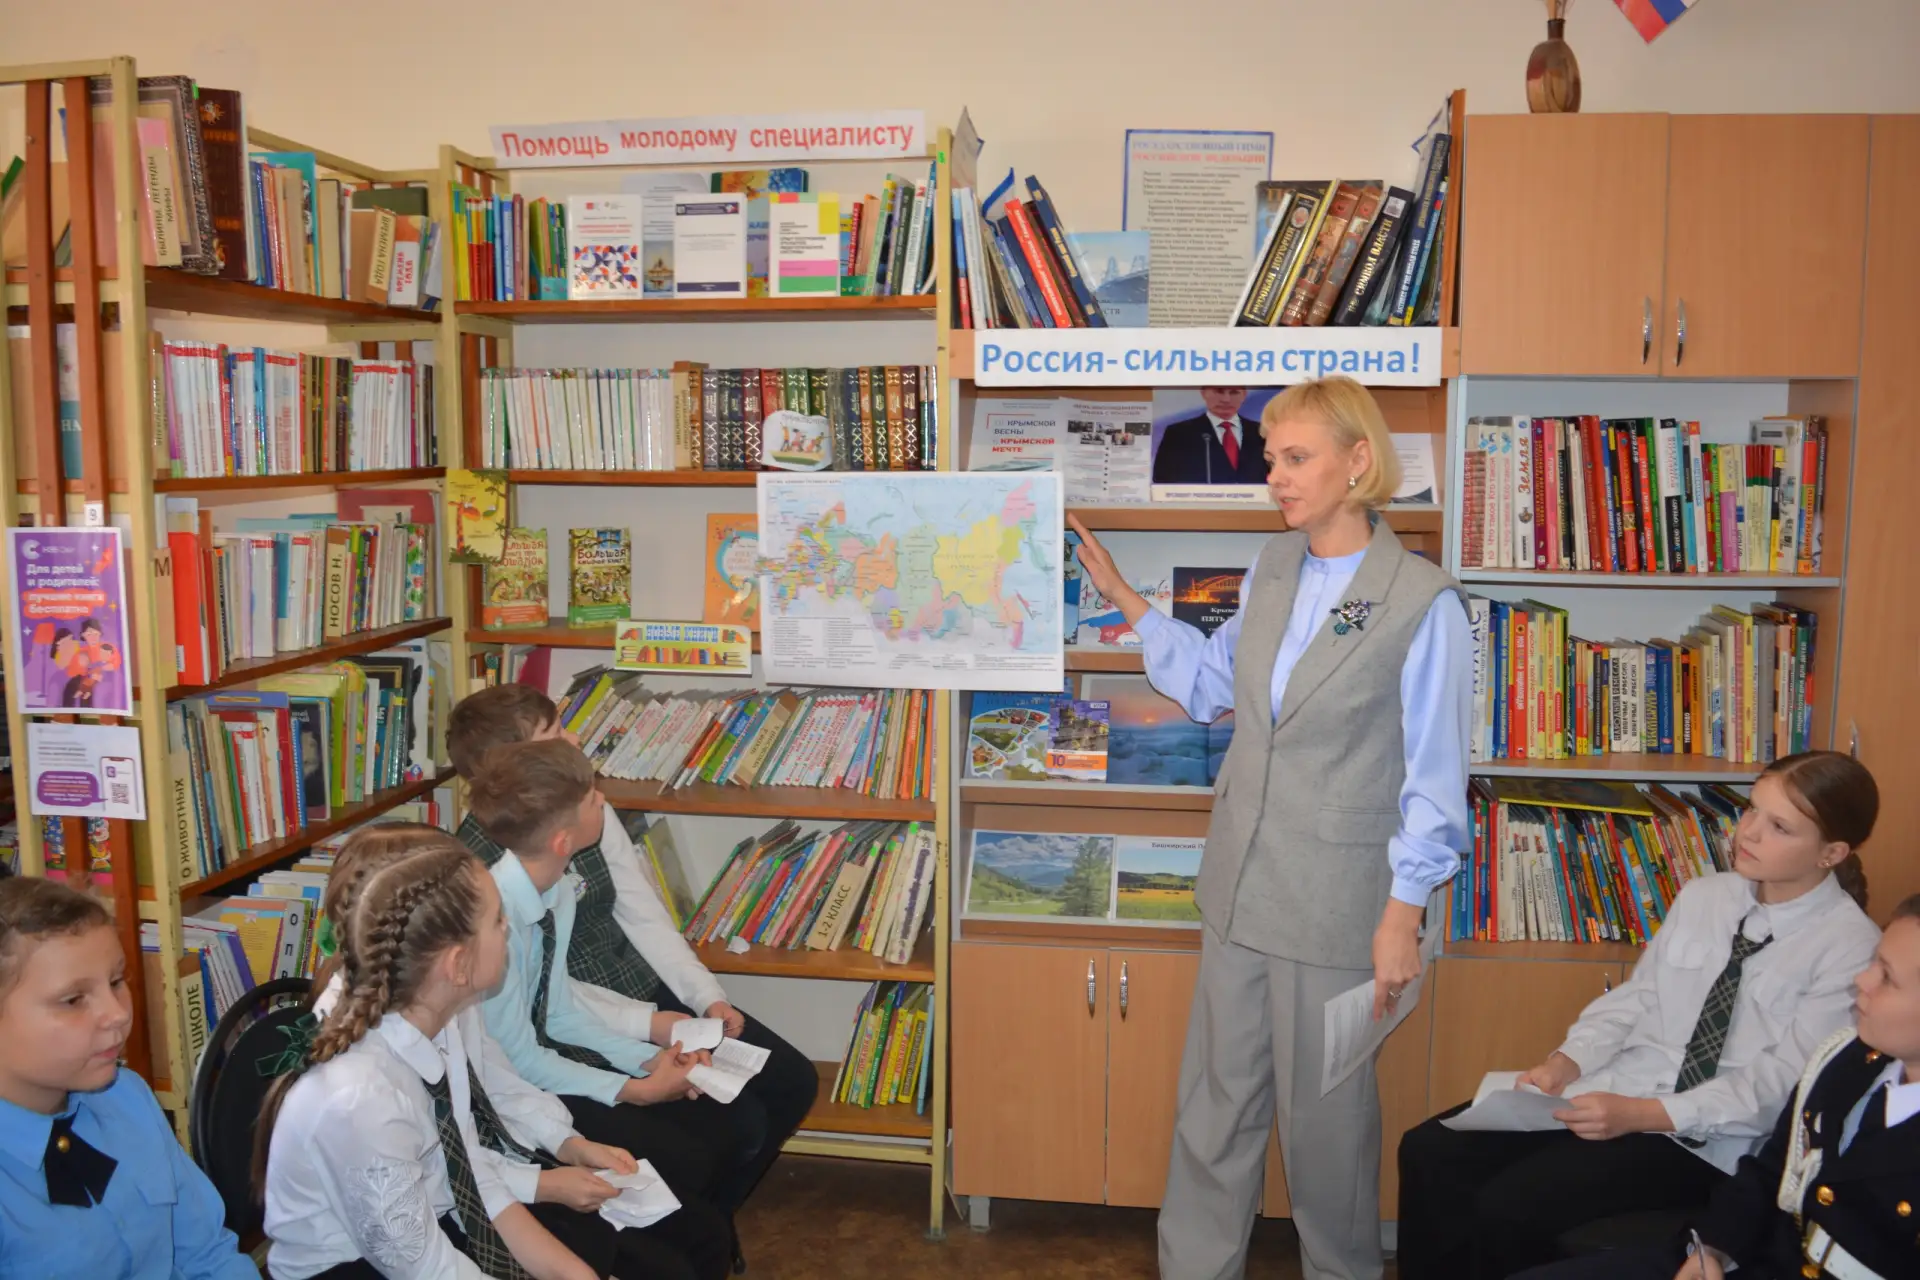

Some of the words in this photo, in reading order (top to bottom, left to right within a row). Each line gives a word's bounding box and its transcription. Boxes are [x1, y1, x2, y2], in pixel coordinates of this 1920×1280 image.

[501, 133, 610, 159] Помощь
[620, 129, 737, 151] молодому
[750, 125, 914, 150] специалисту
[1354, 254, 1376, 296] СИМВОЛ
[1370, 219, 1393, 257] ВЛАСТИ
[982, 343, 1117, 373] Россия-
[1124, 348, 1274, 373] сильная
[1281, 342, 1420, 378] страна!
[1007, 419, 1056, 427] КРЫМСКОЙ
[1519, 436, 1531, 495] Земля
[155, 556, 170, 577] М
[330, 574, 341, 627] НОСОВ
[646, 624, 681, 641] НОВЫЕ
[684, 626, 719, 643] КНИГИ
[1050, 753, 1066, 767] 10
[174, 778, 191, 864] ЖИВОТНЫХ
[182, 867, 192, 878] О
[816, 920, 835, 941] 1-2
[829, 884, 852, 920] КЛАСС
[186, 983, 204, 1048] ШКОЛЕ
